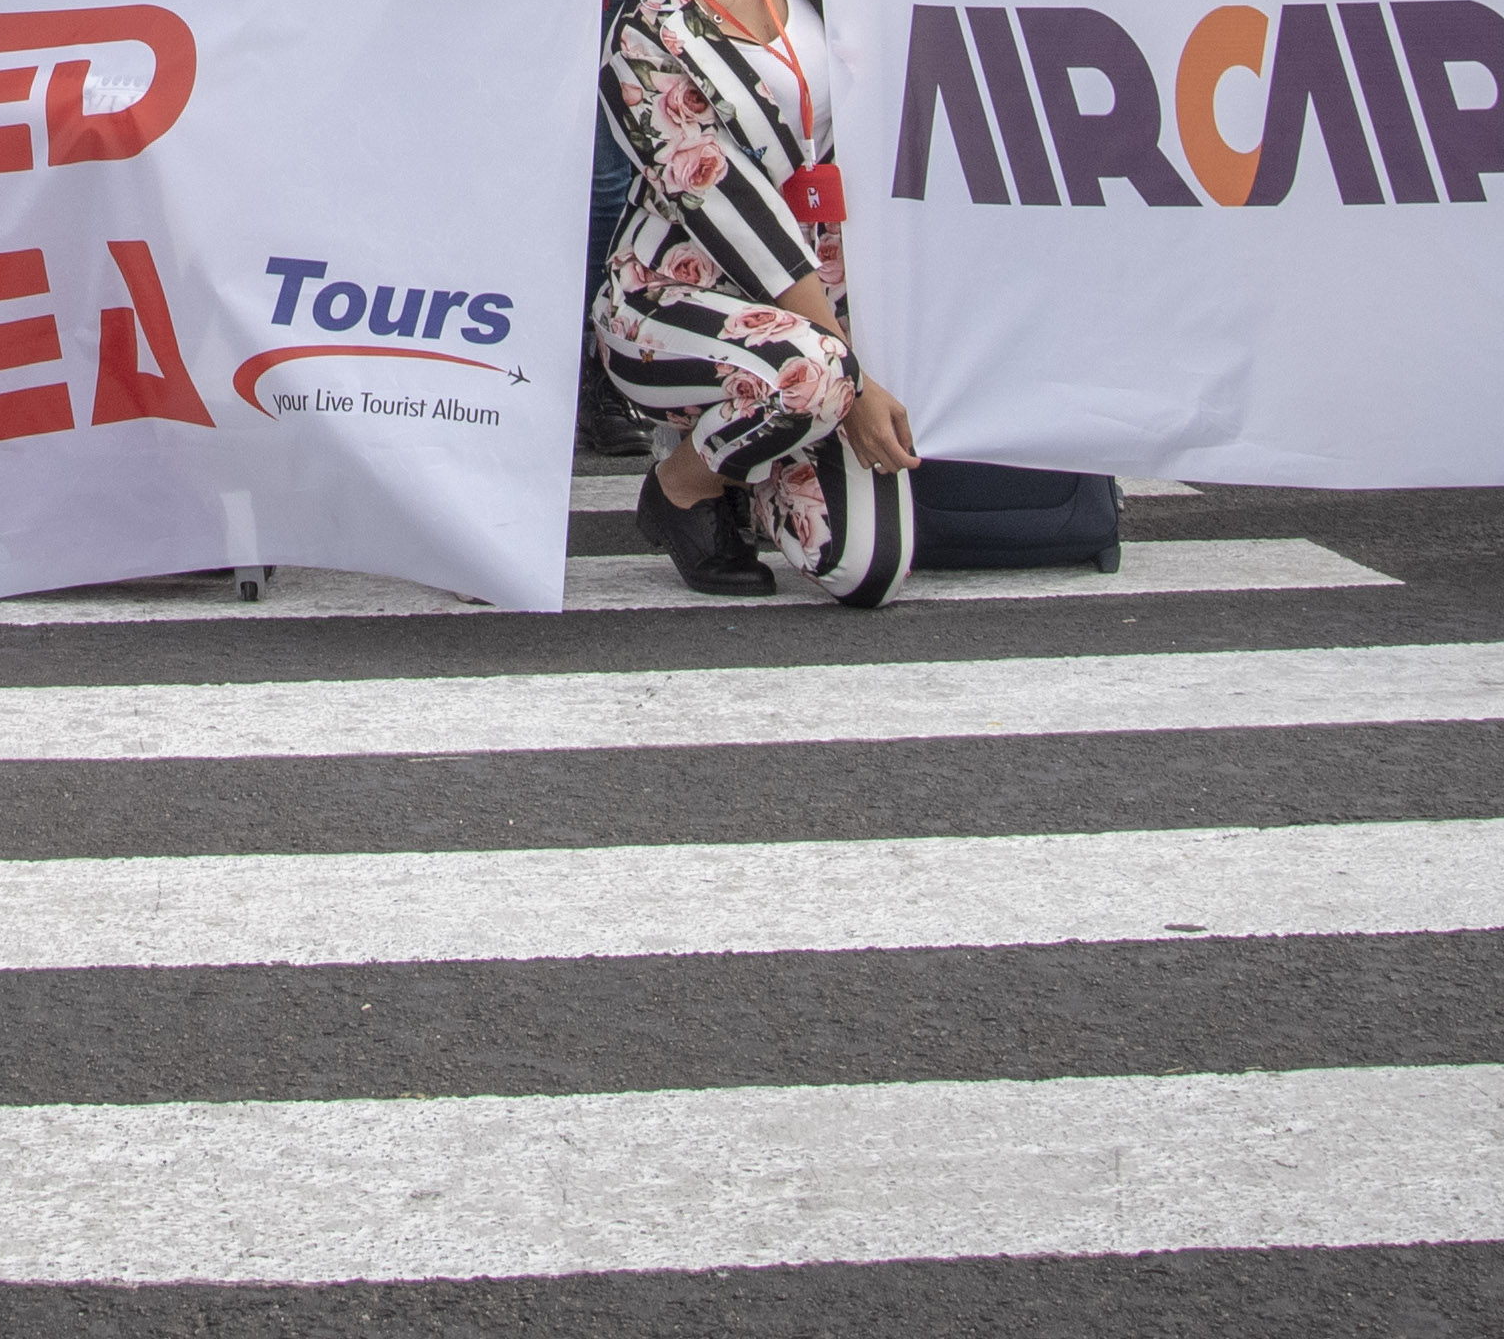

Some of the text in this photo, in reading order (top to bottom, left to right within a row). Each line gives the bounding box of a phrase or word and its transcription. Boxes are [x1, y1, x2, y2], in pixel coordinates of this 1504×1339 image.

[265, 256, 515, 345] Tours
[272, 388, 500, 426] your Live Tourist Album
